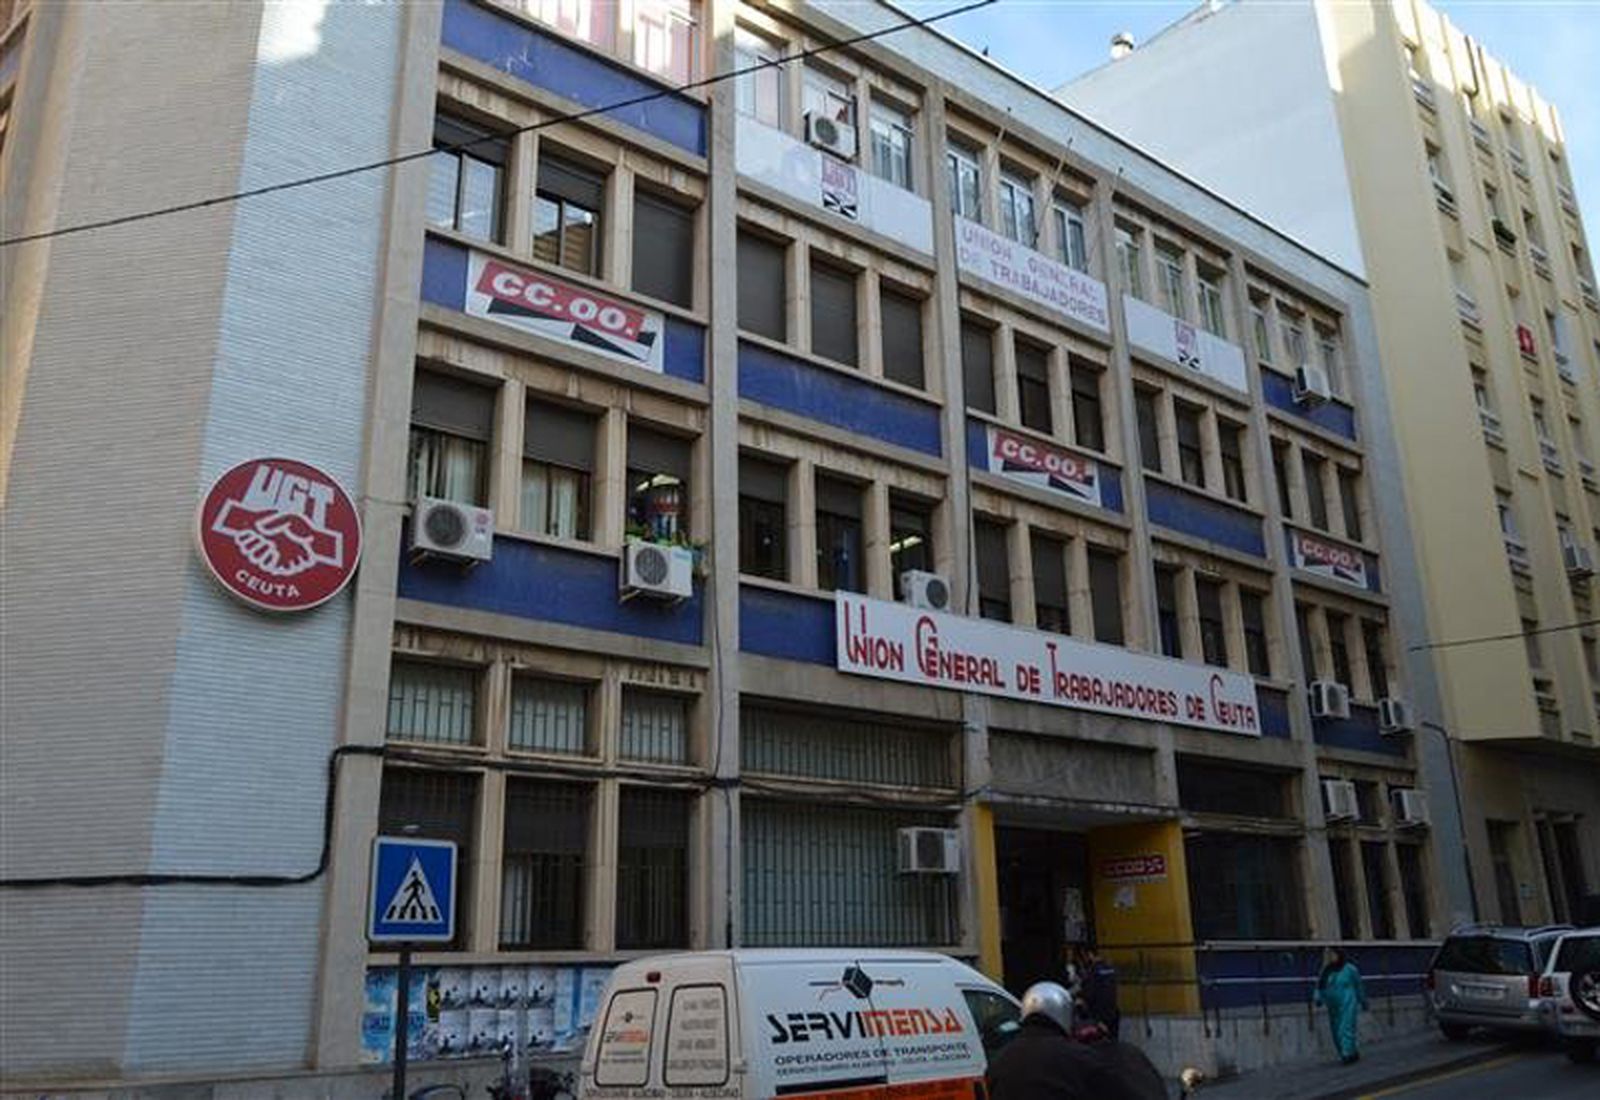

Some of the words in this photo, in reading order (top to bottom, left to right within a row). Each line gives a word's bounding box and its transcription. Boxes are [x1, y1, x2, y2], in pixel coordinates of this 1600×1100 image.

[492, 271, 634, 335] CC.OO.
[1001, 438, 1083, 479] CC.OO.
[240, 464, 336, 531] UGT
[235, 568, 301, 598] CEUTA
[843, 600, 905, 673] UNION
[915, 615, 1006, 689] GENERAL
[1015, 663, 1041, 695] DE
[1045, 642, 1179, 717] TRABAJADORES
[1185, 692, 1205, 722] DE
[1209, 673, 1258, 730] CEUTA
[766, 1006, 965, 1045] SERVIMENSA
[774, 1050, 871, 1067] OPERADORES
[893, 1041, 969, 1058] TRANSPORTE
